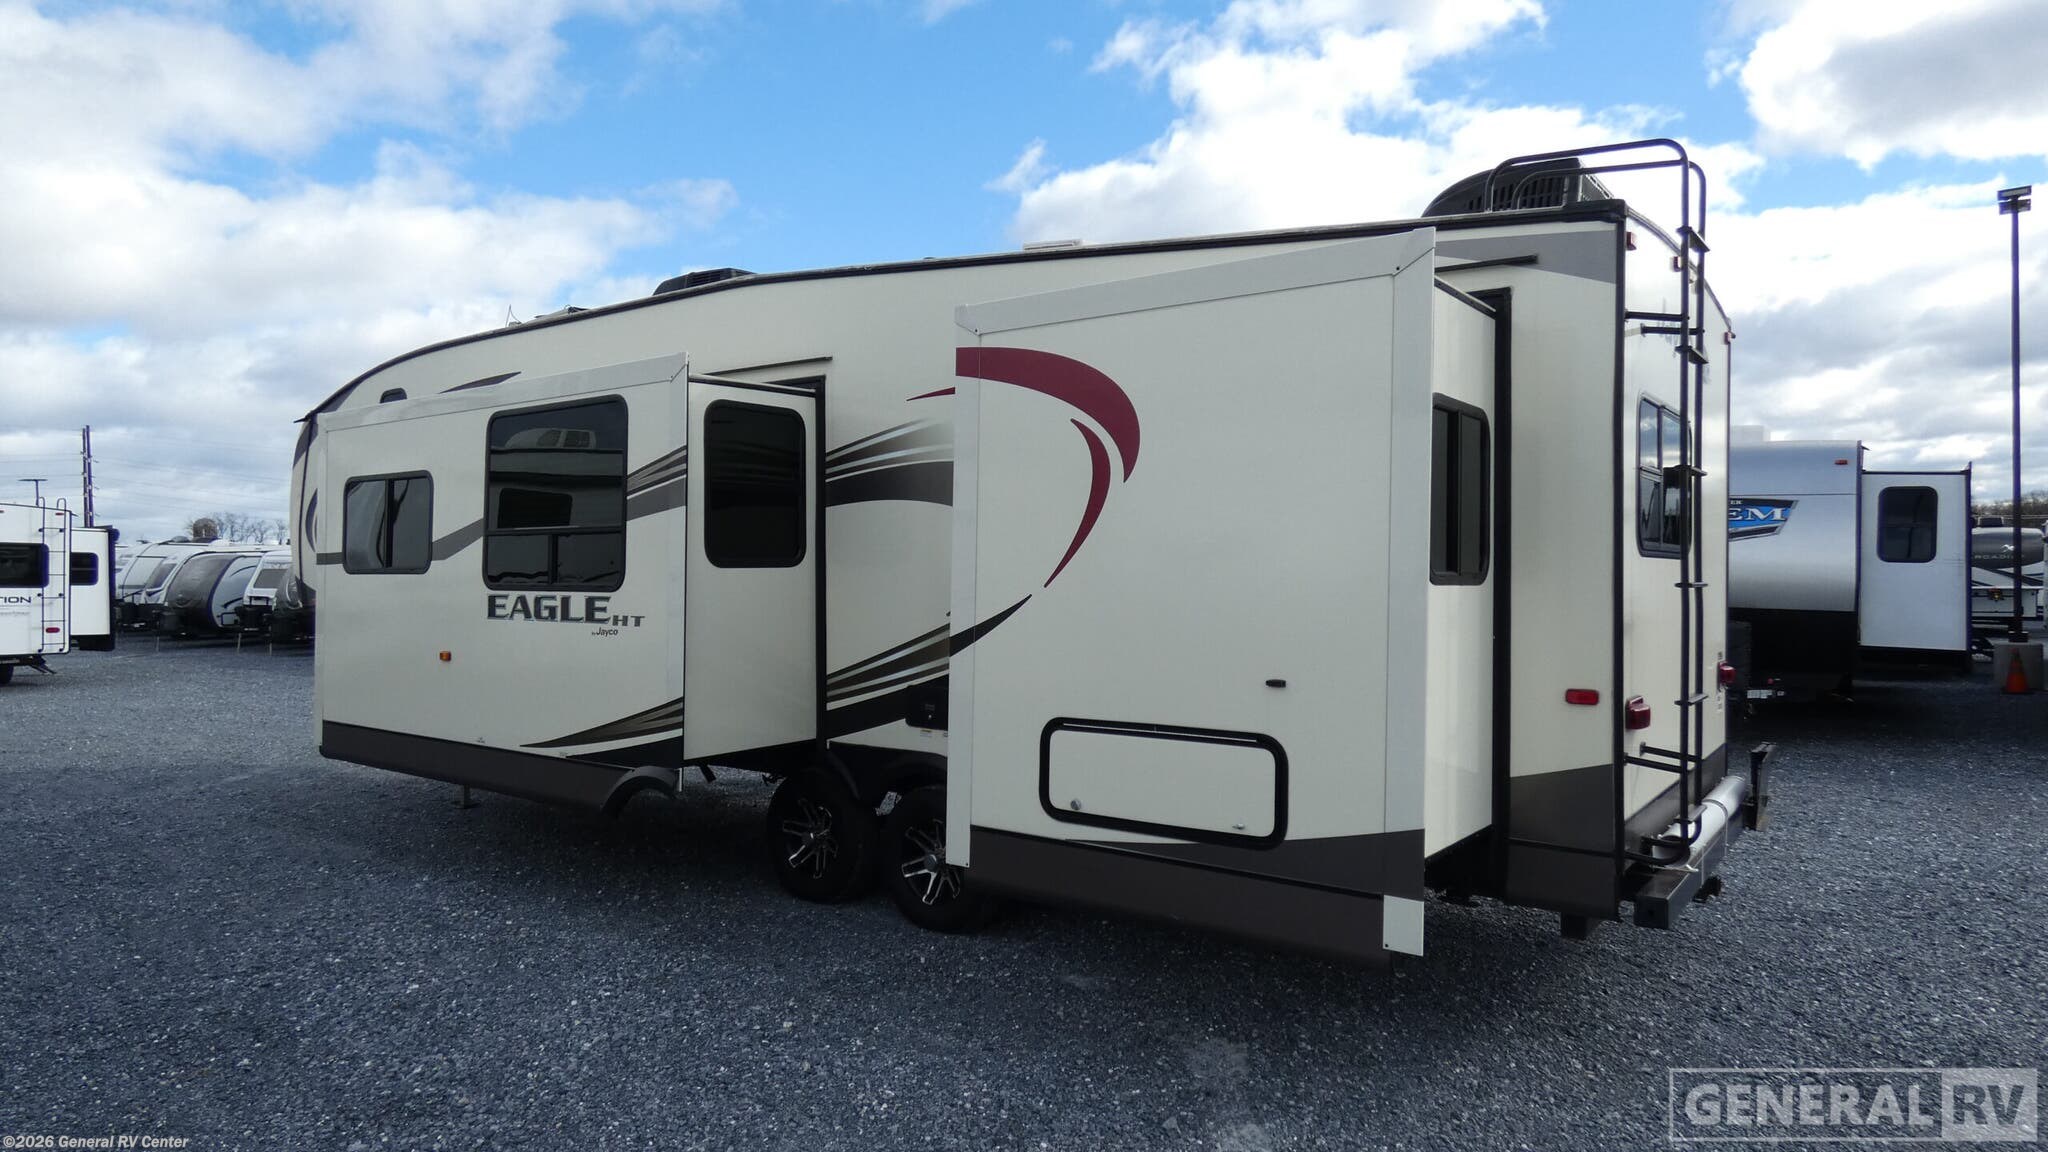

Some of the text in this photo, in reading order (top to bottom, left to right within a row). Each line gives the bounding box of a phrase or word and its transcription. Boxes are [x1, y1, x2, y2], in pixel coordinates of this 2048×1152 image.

[1729, 507, 1786, 520] EM
[487, 594, 645, 627] EAGLE HT
[596, 627, 618, 638] Jayco
